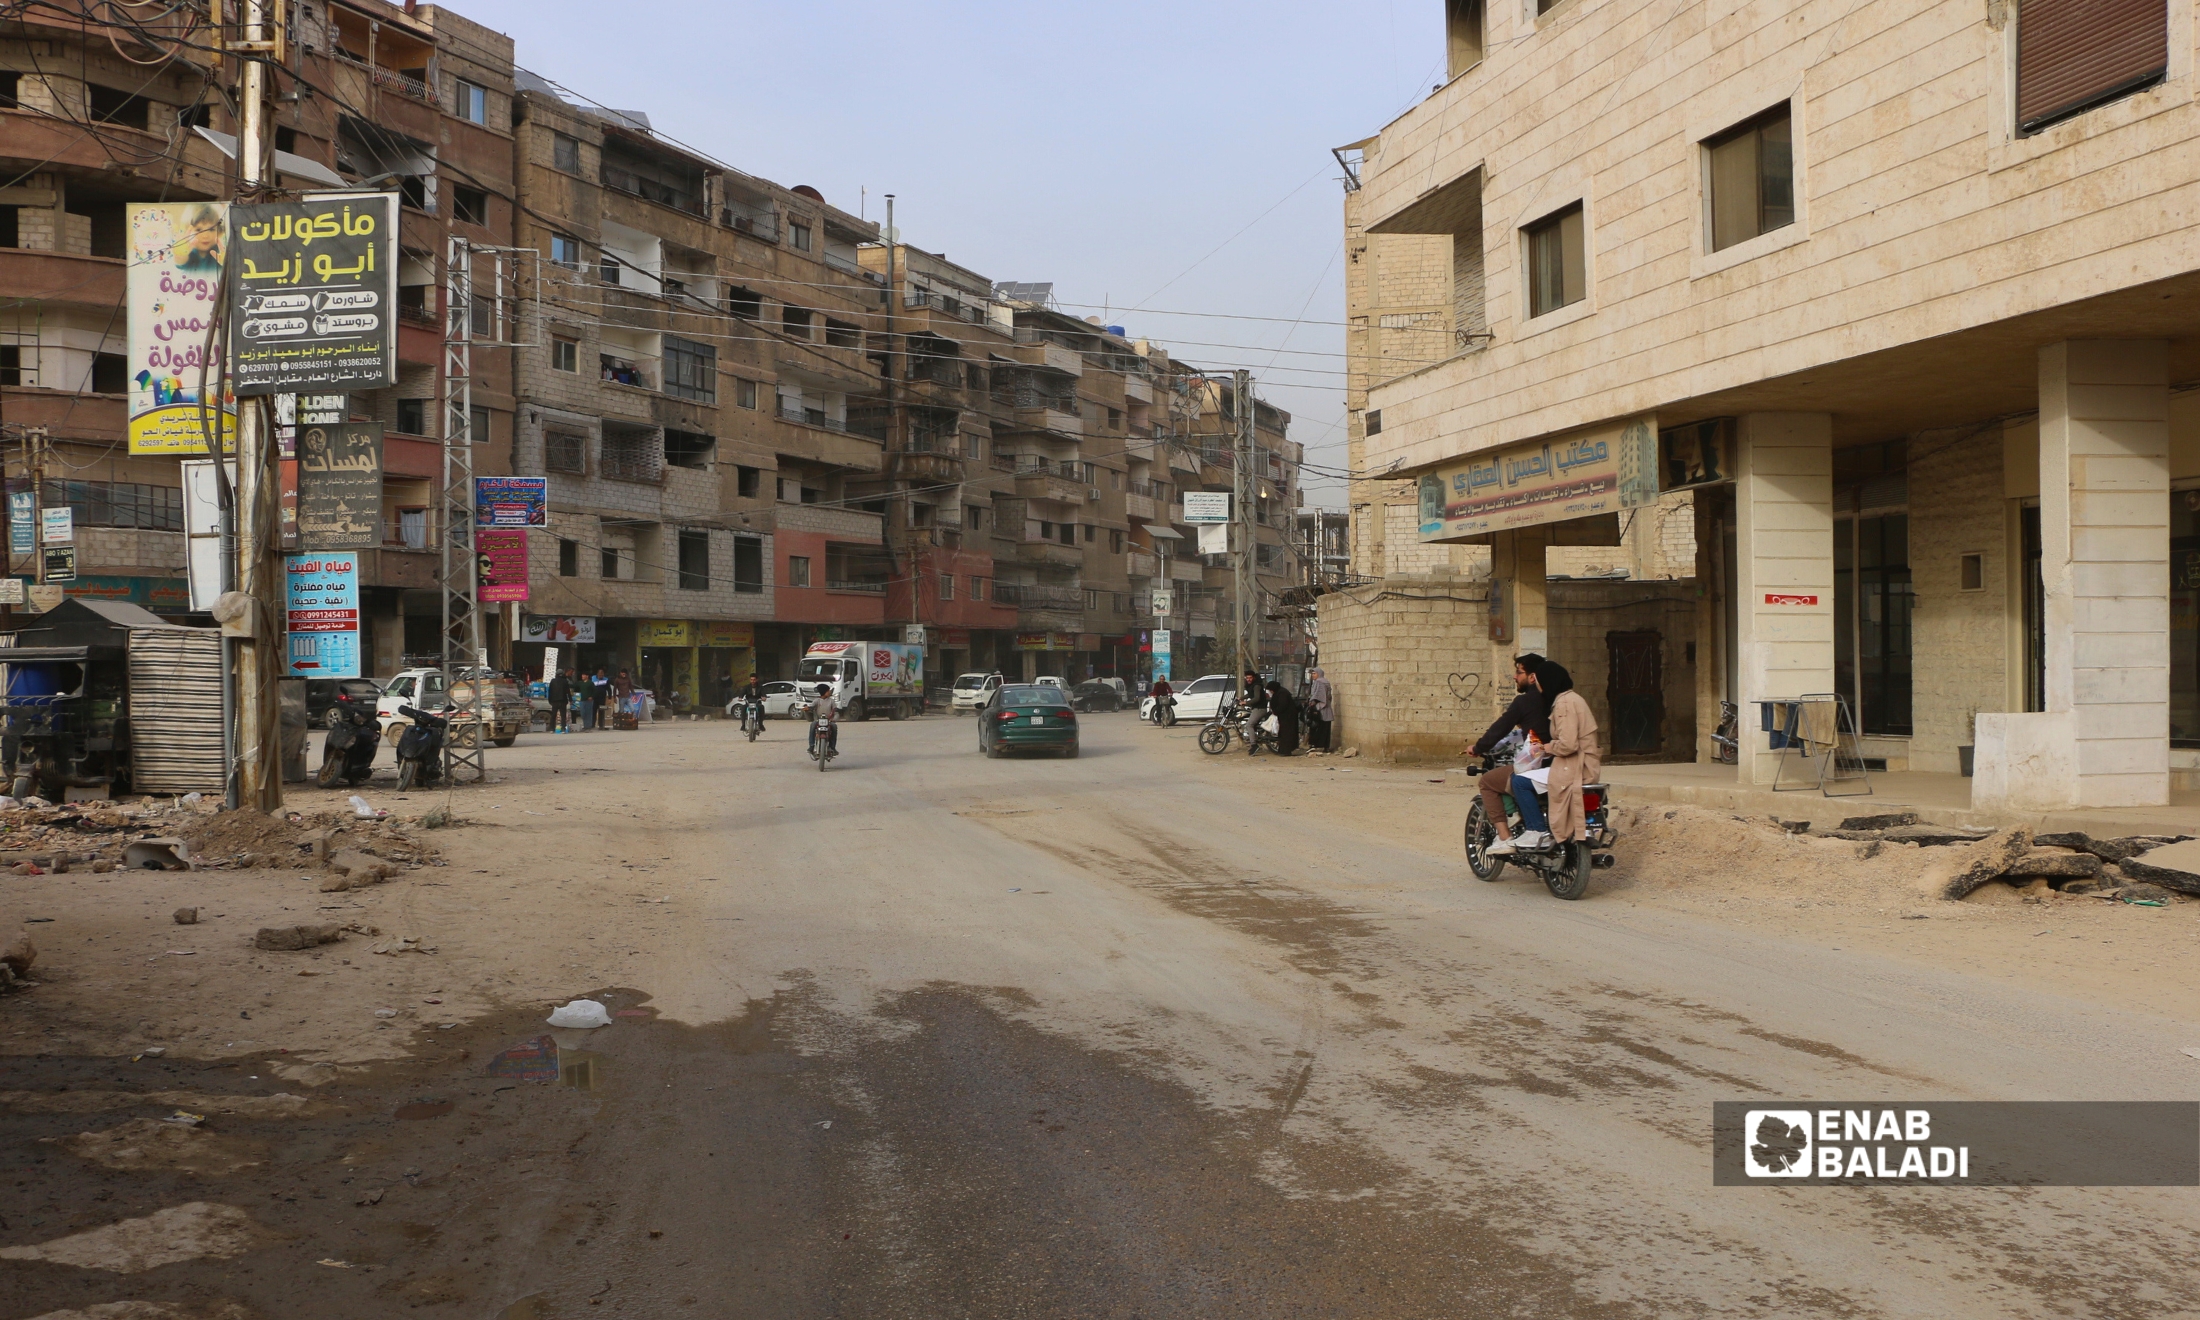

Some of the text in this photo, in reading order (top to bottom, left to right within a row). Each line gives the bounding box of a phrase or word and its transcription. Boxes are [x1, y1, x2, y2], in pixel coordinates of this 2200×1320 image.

[241, 206, 375, 246] مأكولات
[241, 242, 374, 284] أبو زيد
[160, 270, 221, 301] روضة
[264, 298, 306, 309] سمك
[332, 294, 373, 306] شاورما
[263, 320, 305, 333] مشوي
[332, 317, 374, 327] بروستد
[239, 341, 380, 361] أبناء المرحوم أبو سعيد أبو زيد
[148, 345, 229, 375] لطفولة
[248, 357, 381, 372] 0938620052 0955845151 6297070
[238, 369, 382, 387] داريا الشارع العام مقابل المخفر
[297, 395, 344, 411] OLDEN
[297, 412, 340, 424] HONE
[346, 432, 371, 447] مركز
[302, 447, 378, 474] لمسات
[1452, 438, 1609, 497] مكتب الحسن العقاري
[325, 477, 346, 486] بالكامل
[1589, 480, 1605, 496] بيع
[287, 558, 352, 576] مياه الغيث
[63, 582, 131, 598] صيدلي
[293, 582, 346, 594] مياه مفلترة
[307, 611, 349, 619] 0991245431
[331, 622, 346, 630] خدمة
[654, 629, 672, 637] كمال
